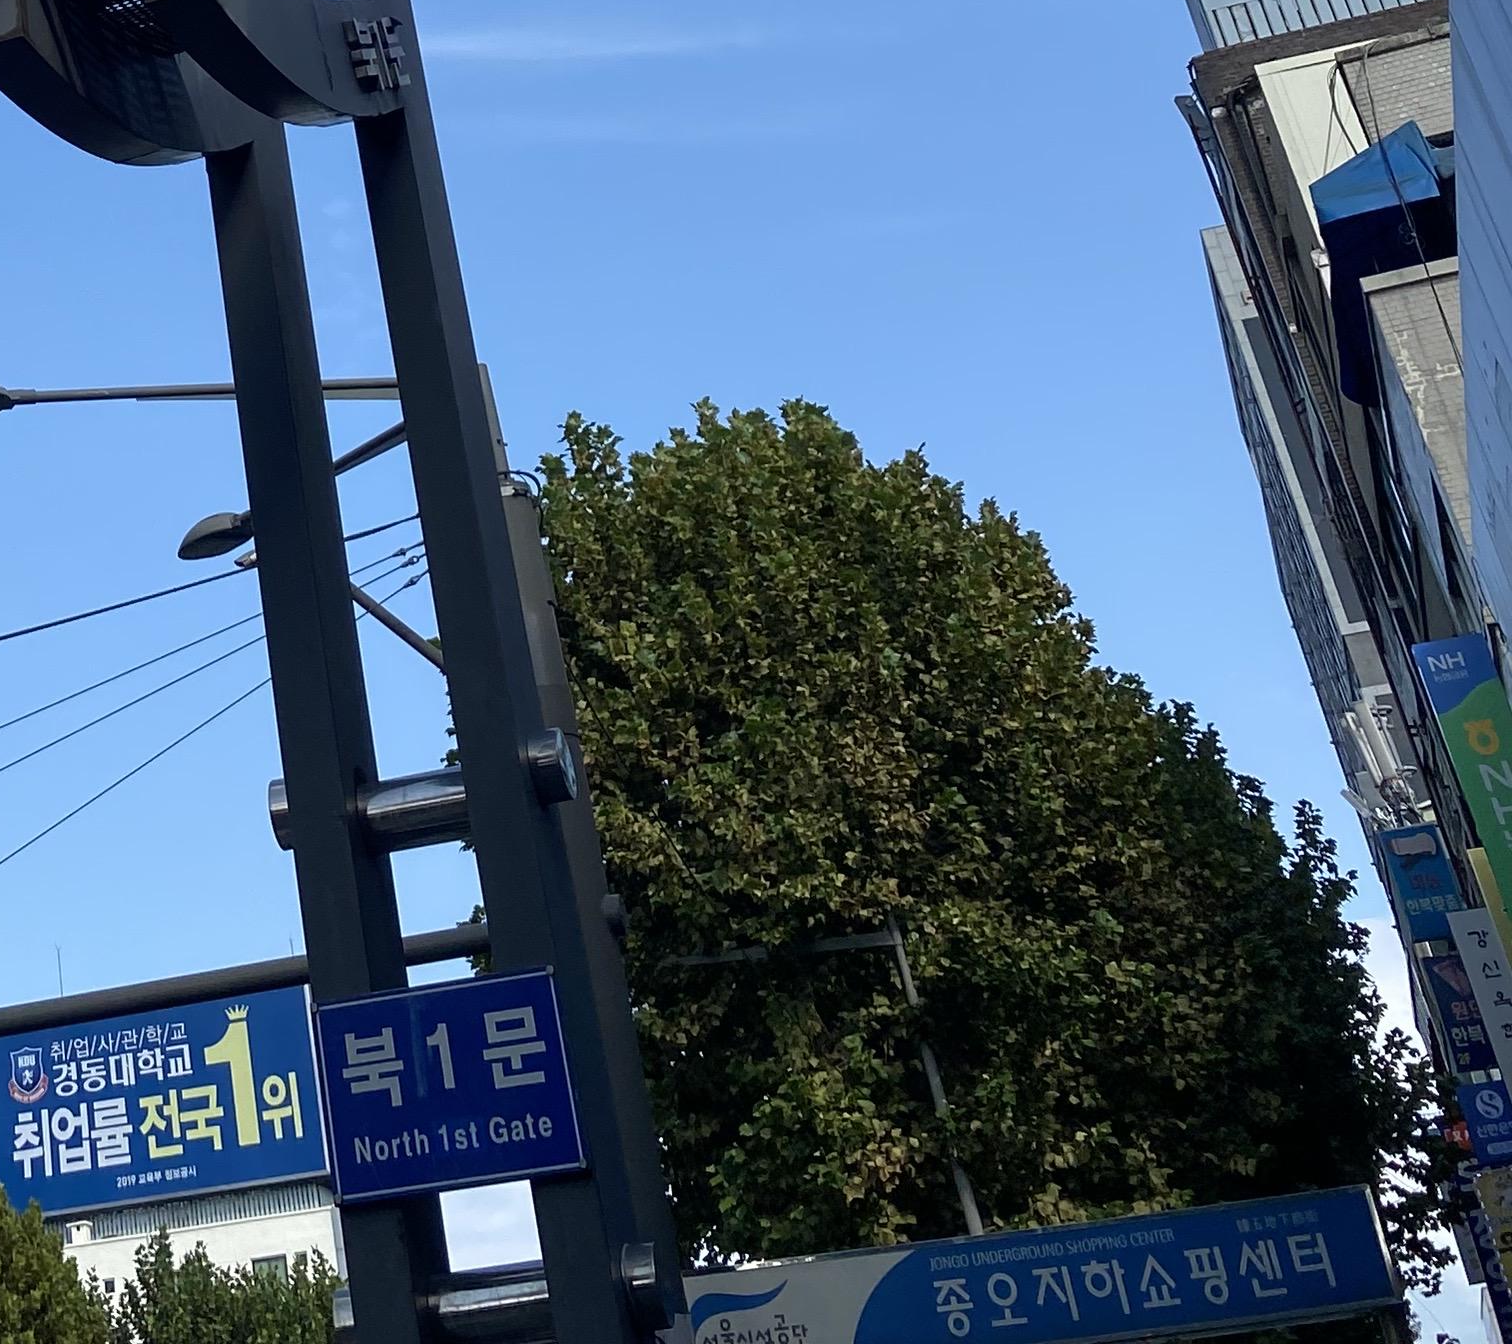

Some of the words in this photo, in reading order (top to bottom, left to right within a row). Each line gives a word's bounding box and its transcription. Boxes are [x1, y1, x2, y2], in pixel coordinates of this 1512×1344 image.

[1427, 651, 1466, 673] NH
[52, 1044, 194, 1097] 경동대학교
[12, 1097, 134, 1179] 취업률
[139, 1084, 225, 1160] 전국
[353, 1128, 430, 1164] North
[438, 1121, 480, 1152] 1st
[489, 1112, 553, 1144] Gate
[116, 1174, 137, 1188] 2019
[929, 1253, 970, 1272] JONGO
[971, 1242, 1064, 1267] UNDERGROUND
[1067, 1234, 1128, 1255] SHOPPING
[1129, 1228, 1176, 1247] CENTER
[933, 1232, 1337, 1338] 종오지하쇼핑센터
